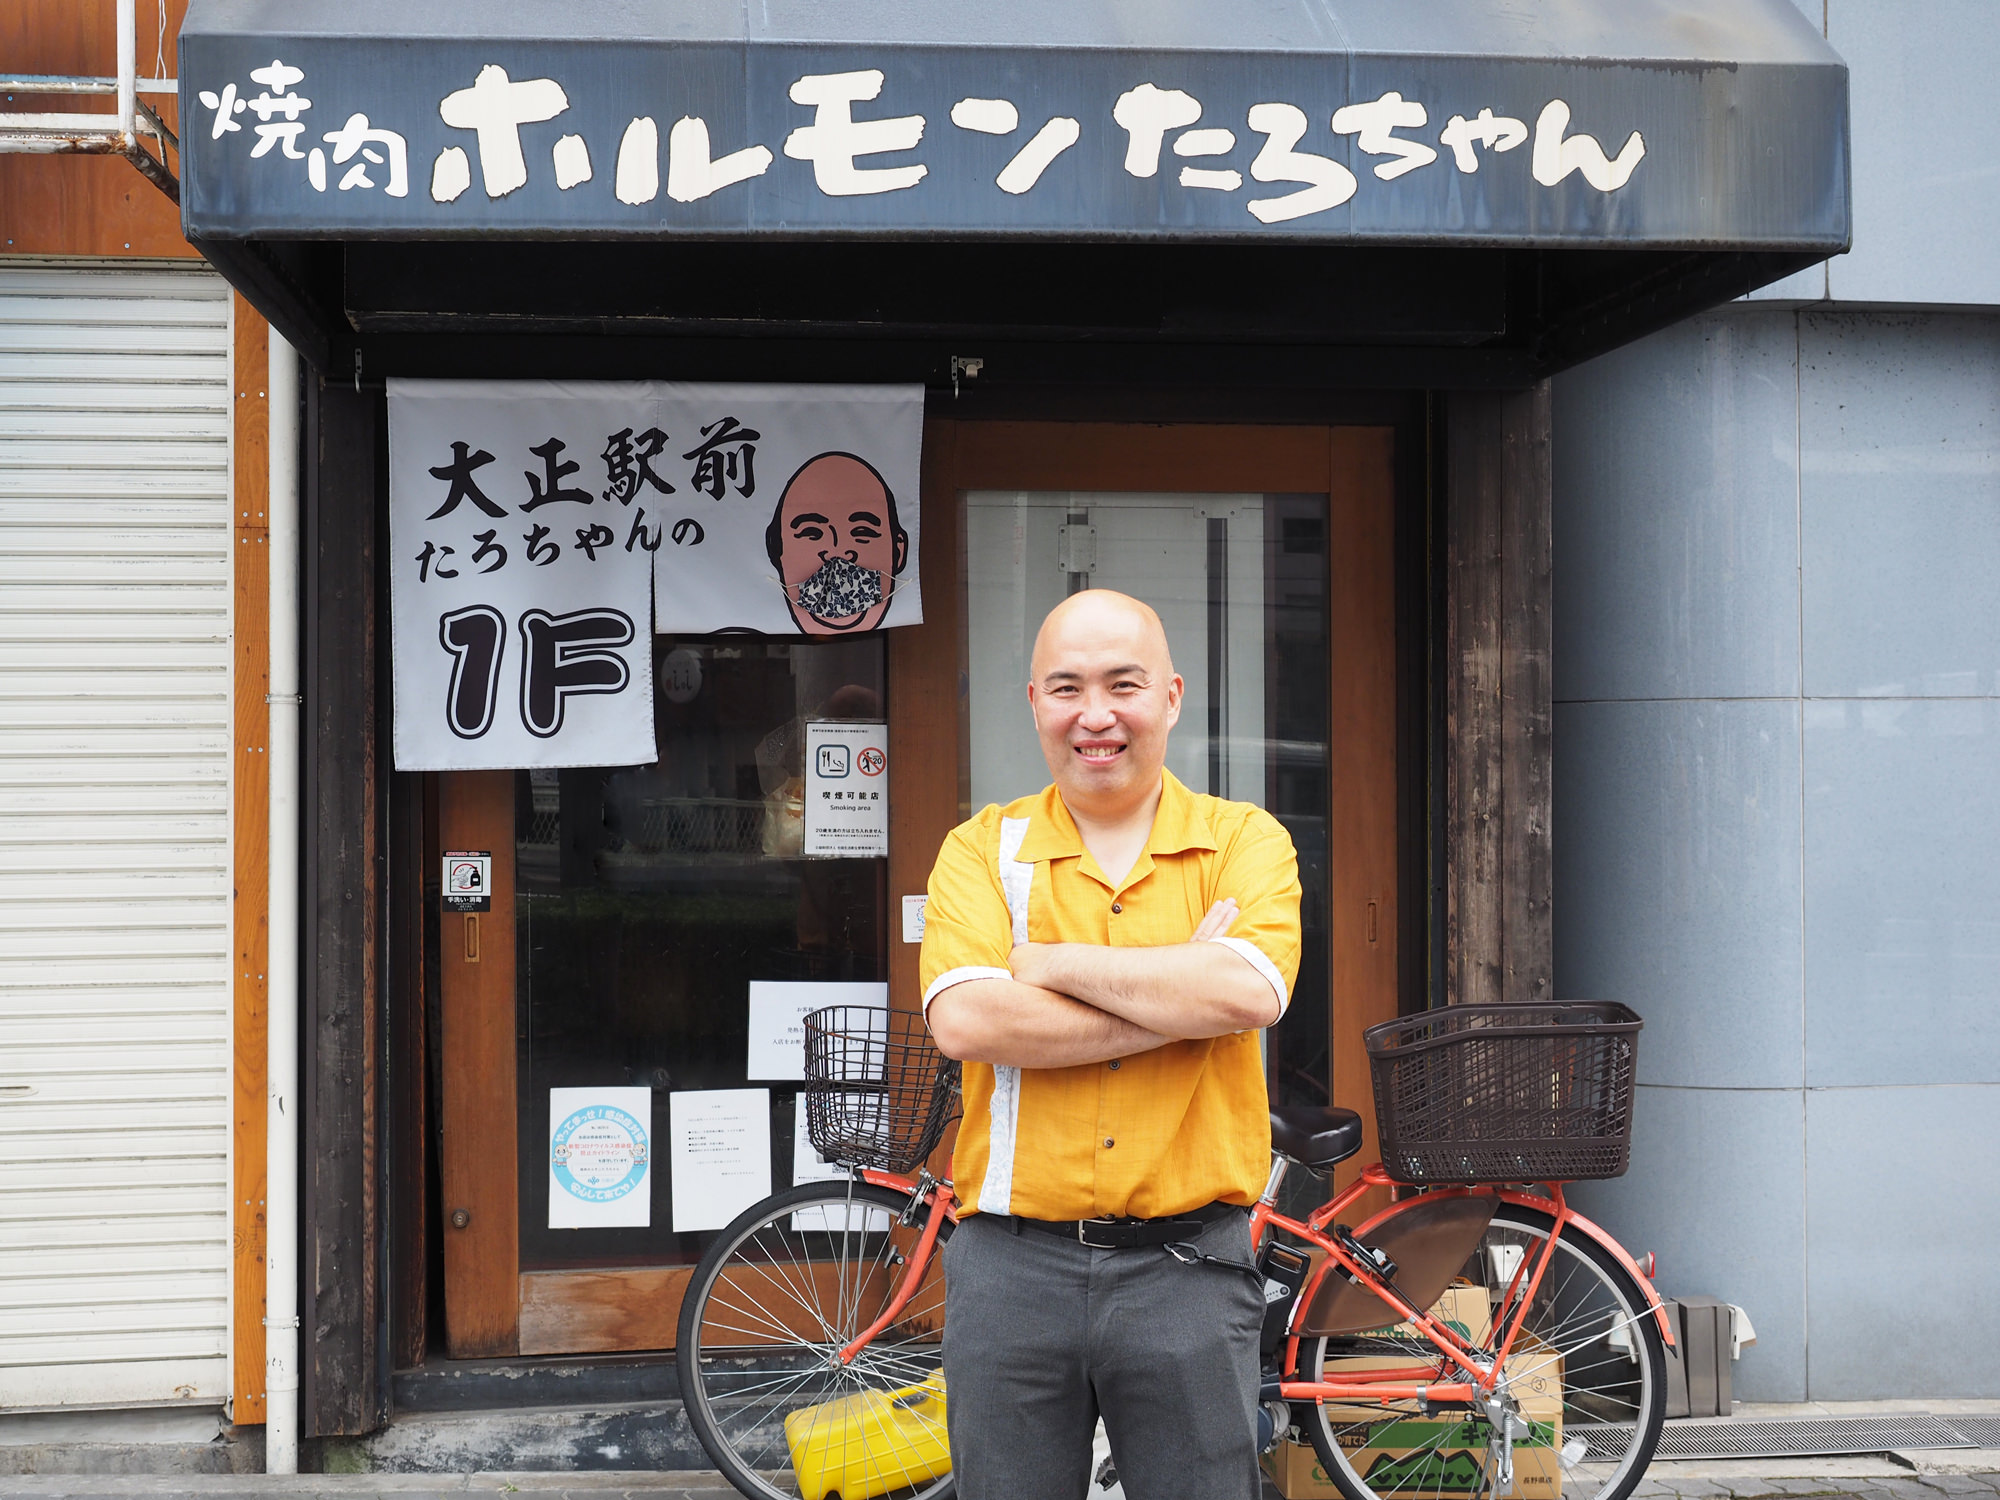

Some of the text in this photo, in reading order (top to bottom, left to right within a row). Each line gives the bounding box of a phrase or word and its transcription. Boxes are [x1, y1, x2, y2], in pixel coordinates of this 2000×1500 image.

[425, 416, 762, 520] 大正駅前
[414, 508, 705, 584] たろちゃんの
[438, 604, 634, 741] 1F
[822, 791, 880, 801] 喫煙可能店
[830, 804, 856, 813] Smoking
